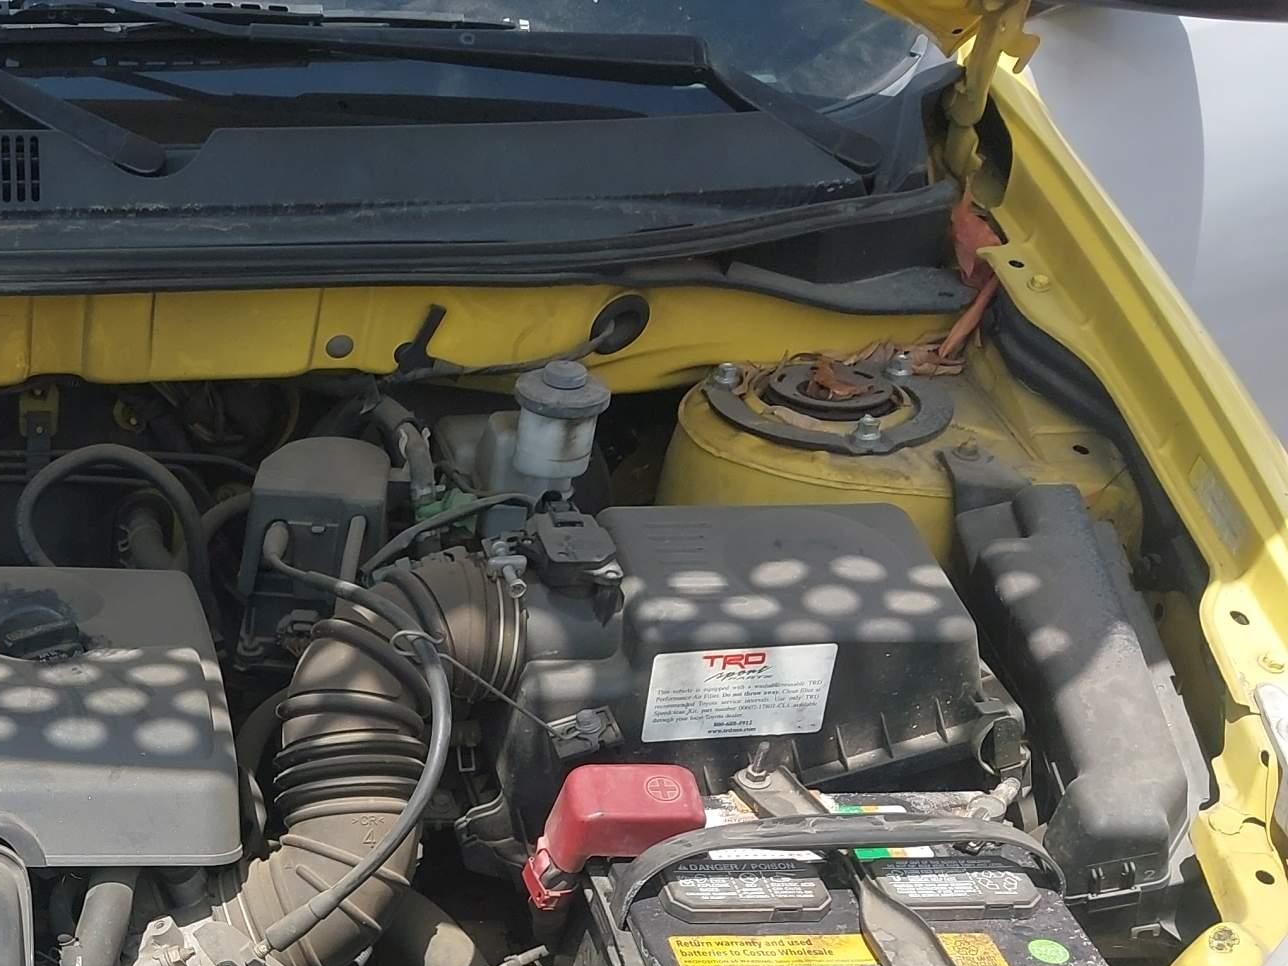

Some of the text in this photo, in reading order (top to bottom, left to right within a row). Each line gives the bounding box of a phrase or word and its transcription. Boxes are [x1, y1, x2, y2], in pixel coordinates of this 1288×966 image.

[703, 653, 767, 670] TRD
[688, 863, 738, 871] DANGER
[750, 862, 796, 871] POISON
[676, 940, 713, 948] Return
[715, 940, 762, 949] warranty
[787, 939, 813, 947] used
[679, 949, 728, 957] batteries
[743, 949, 776, 957] Costco
[778, 948, 834, 956] Wholesale
